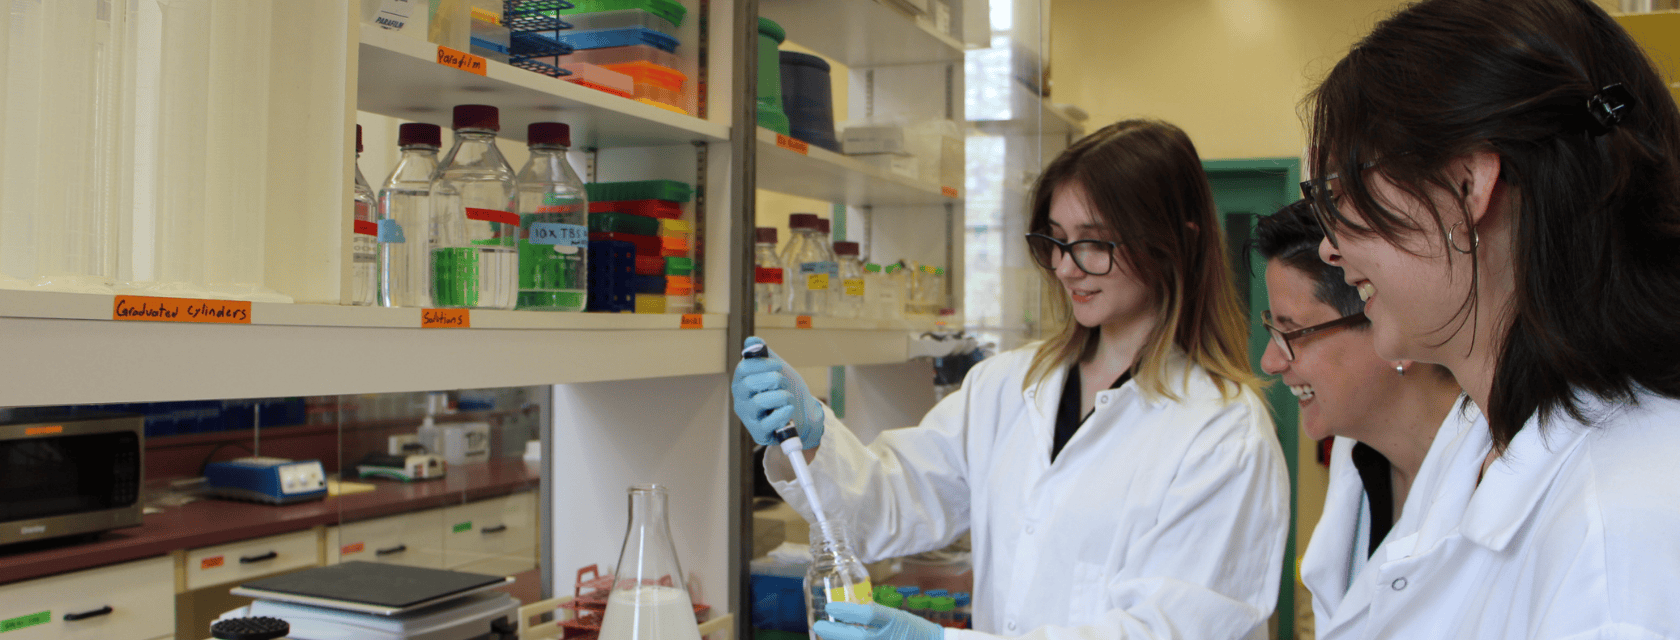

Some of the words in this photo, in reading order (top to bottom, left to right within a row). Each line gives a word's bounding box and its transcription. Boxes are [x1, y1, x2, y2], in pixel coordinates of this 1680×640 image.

[438, 49, 481, 69] Parafilm
[116, 299, 178, 317] Graduated
[423, 311, 463, 325] Solutions
